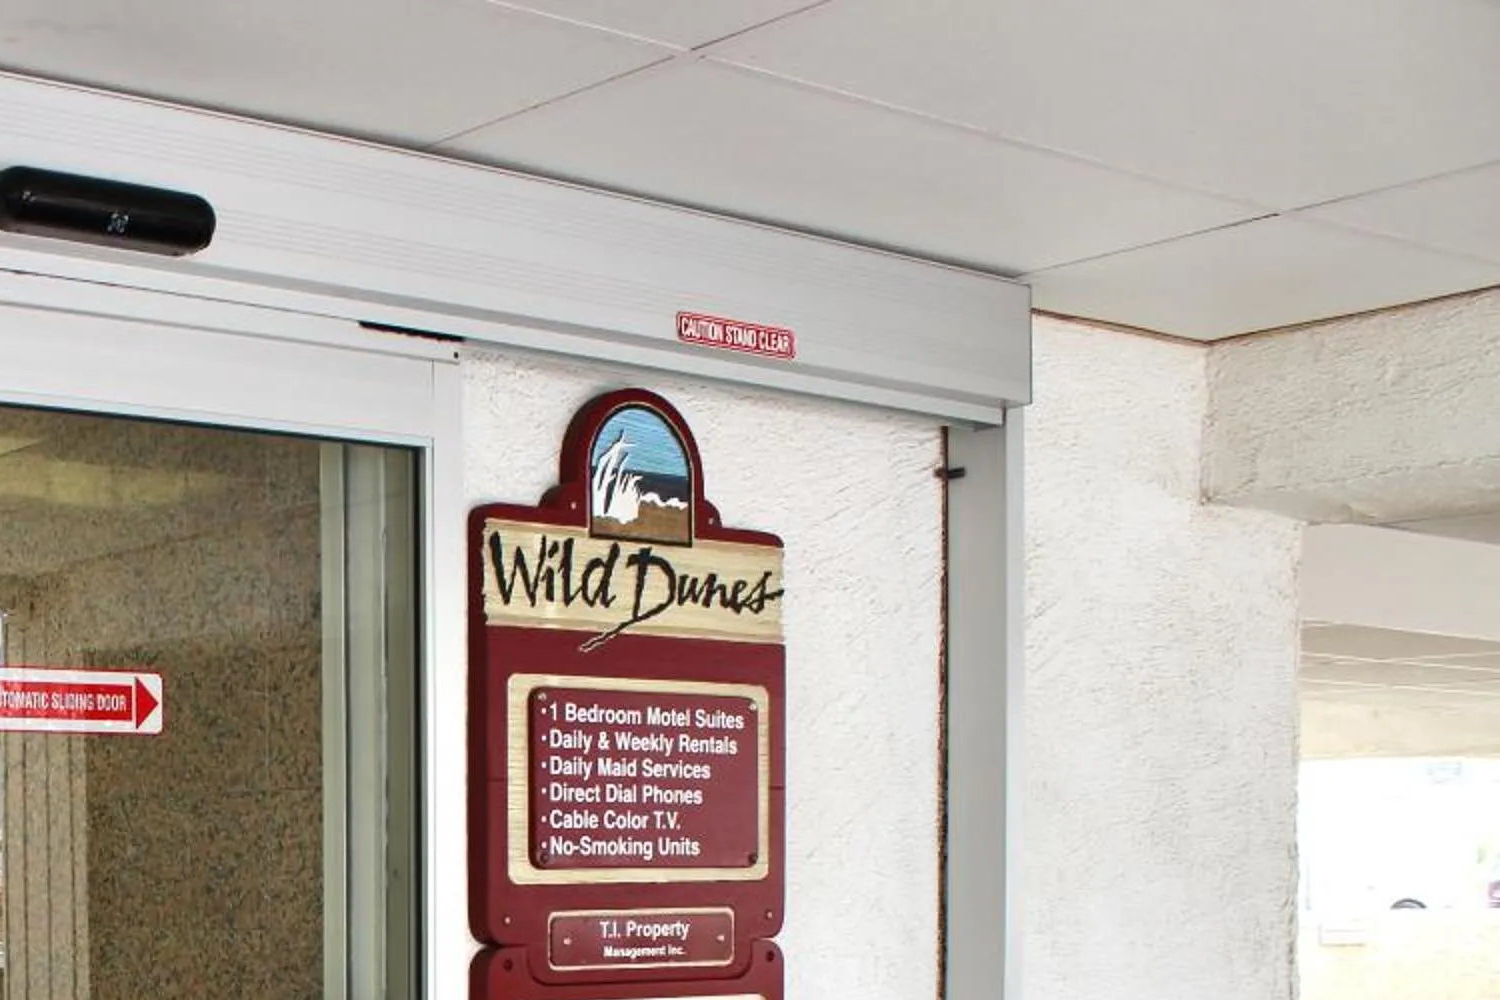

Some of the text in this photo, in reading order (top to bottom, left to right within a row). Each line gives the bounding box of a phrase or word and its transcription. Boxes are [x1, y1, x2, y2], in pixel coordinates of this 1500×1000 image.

[489, 531, 785, 652] Wild Dunes
[51, 692, 94, 711] SLIDING
[97, 694, 126, 712] DOOR
[550, 703, 744, 729] 1 Bedroom Motel Suites
[550, 729, 738, 756] Daily & Weekly Rentals
[550, 756, 711, 780] Daily Maid Services
[550, 783, 703, 805] Direct Dial Phones
[550, 810, 681, 830] Cable Color T.V.
[550, 836, 700, 860] No-Smoking Units
[600, 920, 690, 941] T.I. Property
[604, 944, 665, 960] Management
